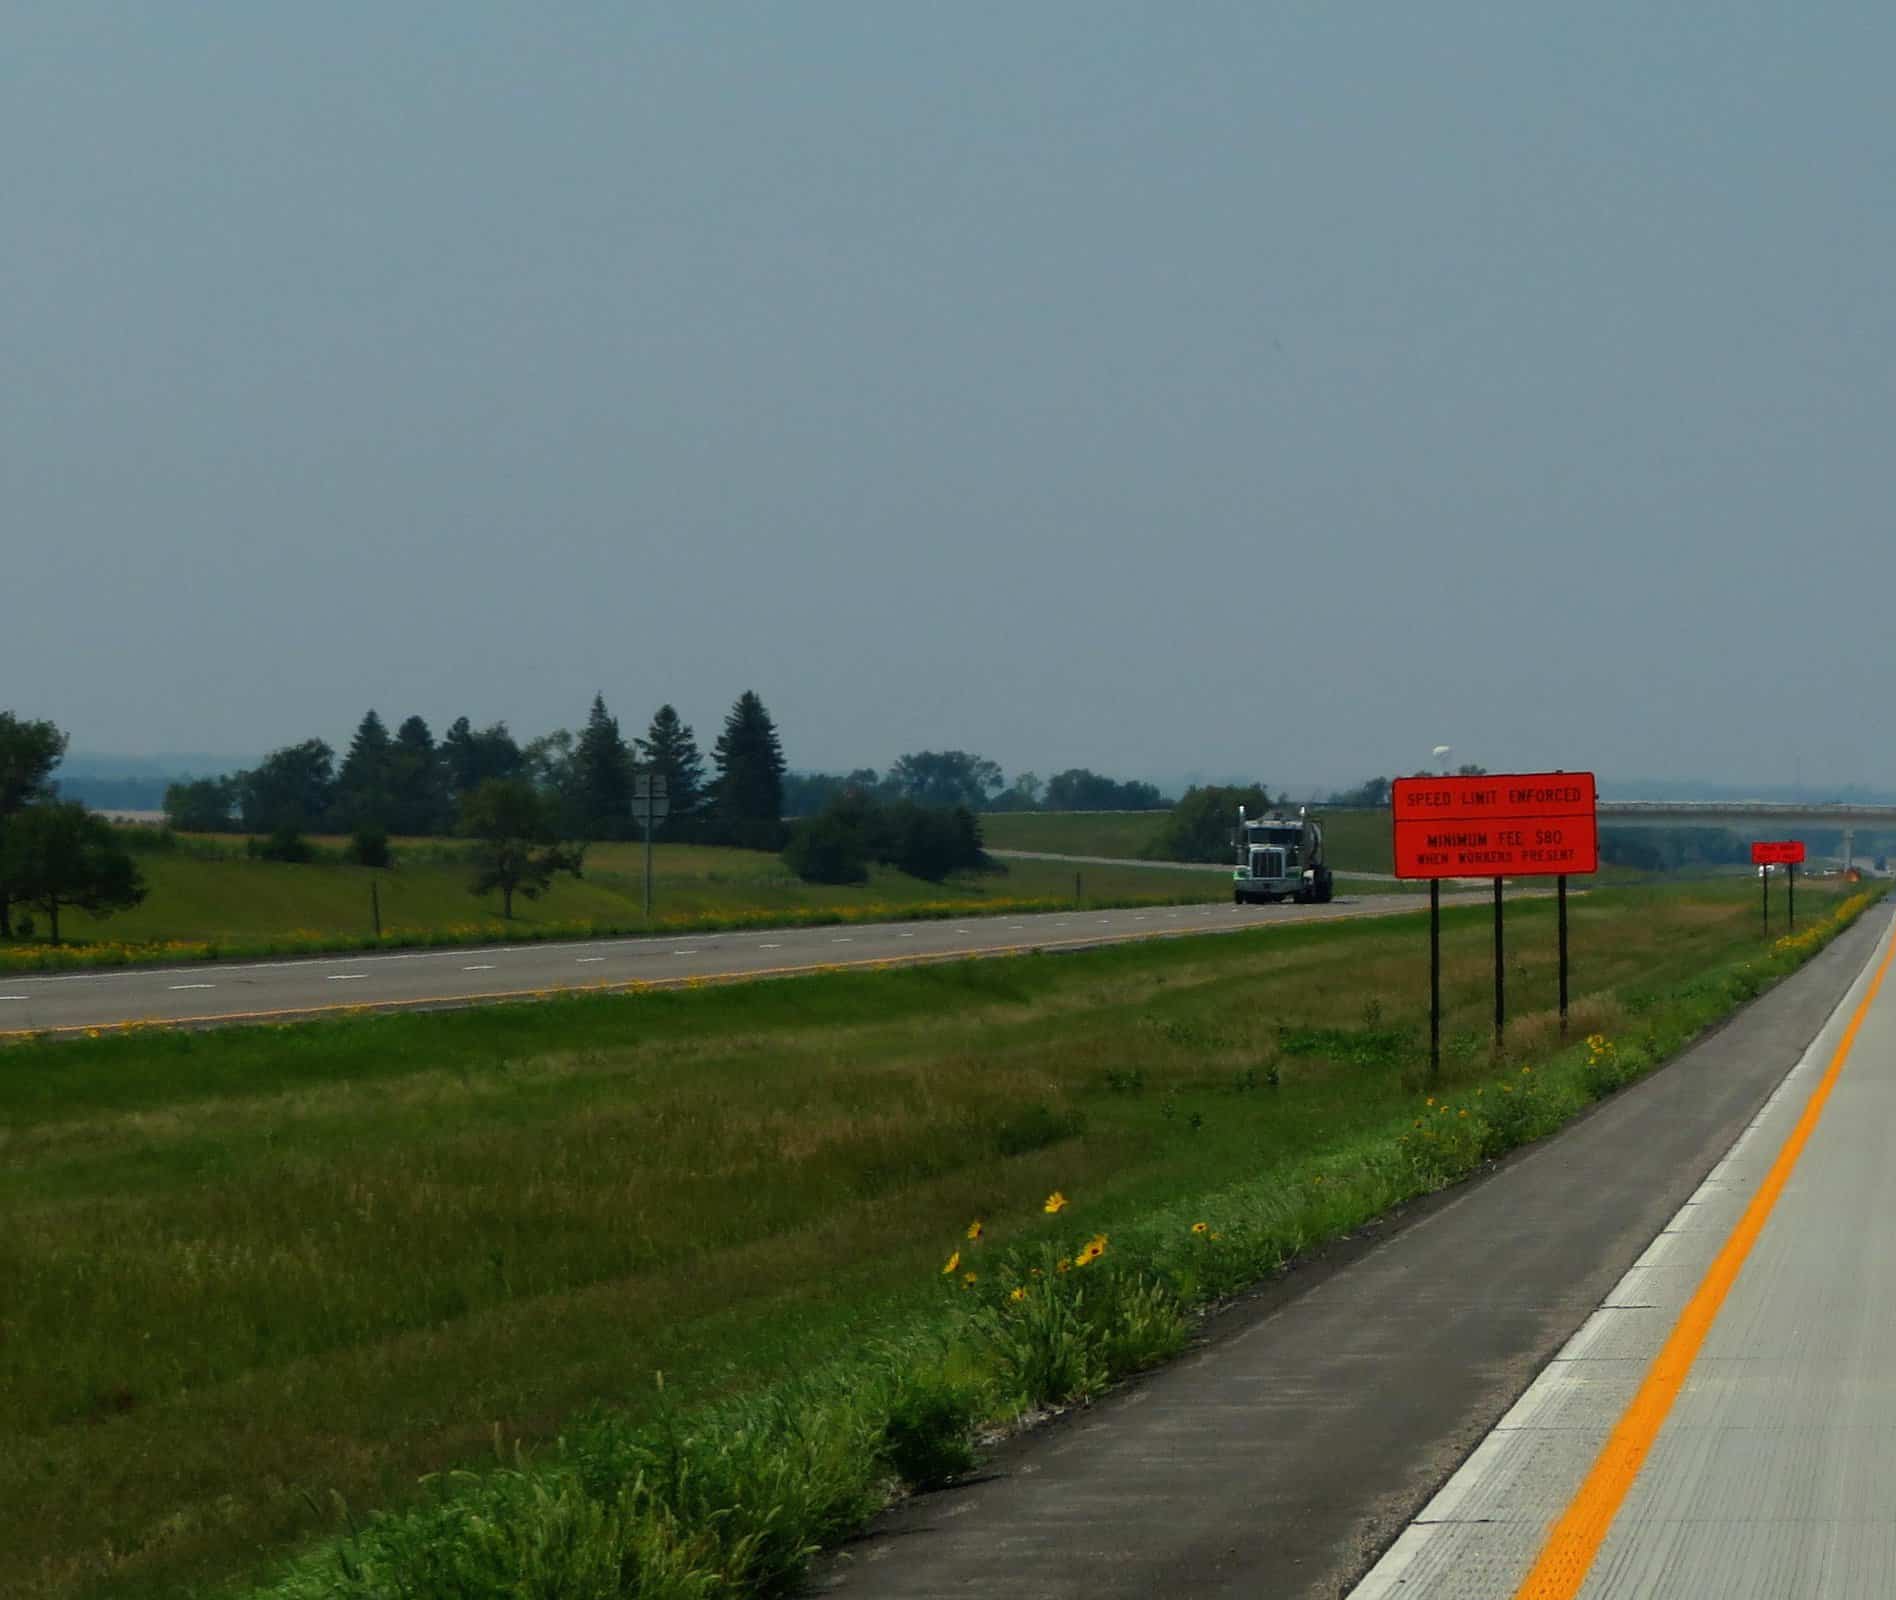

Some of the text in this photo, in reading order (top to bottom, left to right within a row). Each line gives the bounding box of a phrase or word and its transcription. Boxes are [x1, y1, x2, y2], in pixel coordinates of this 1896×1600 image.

[1407, 788, 1581, 806] SPEED LIMIT ENFORCED
[1427, 833, 1487, 848] MINIMUM
[1499, 832, 1523, 845] FEE
[1416, 849, 1575, 864] WHEN WORKERS PRESENT
